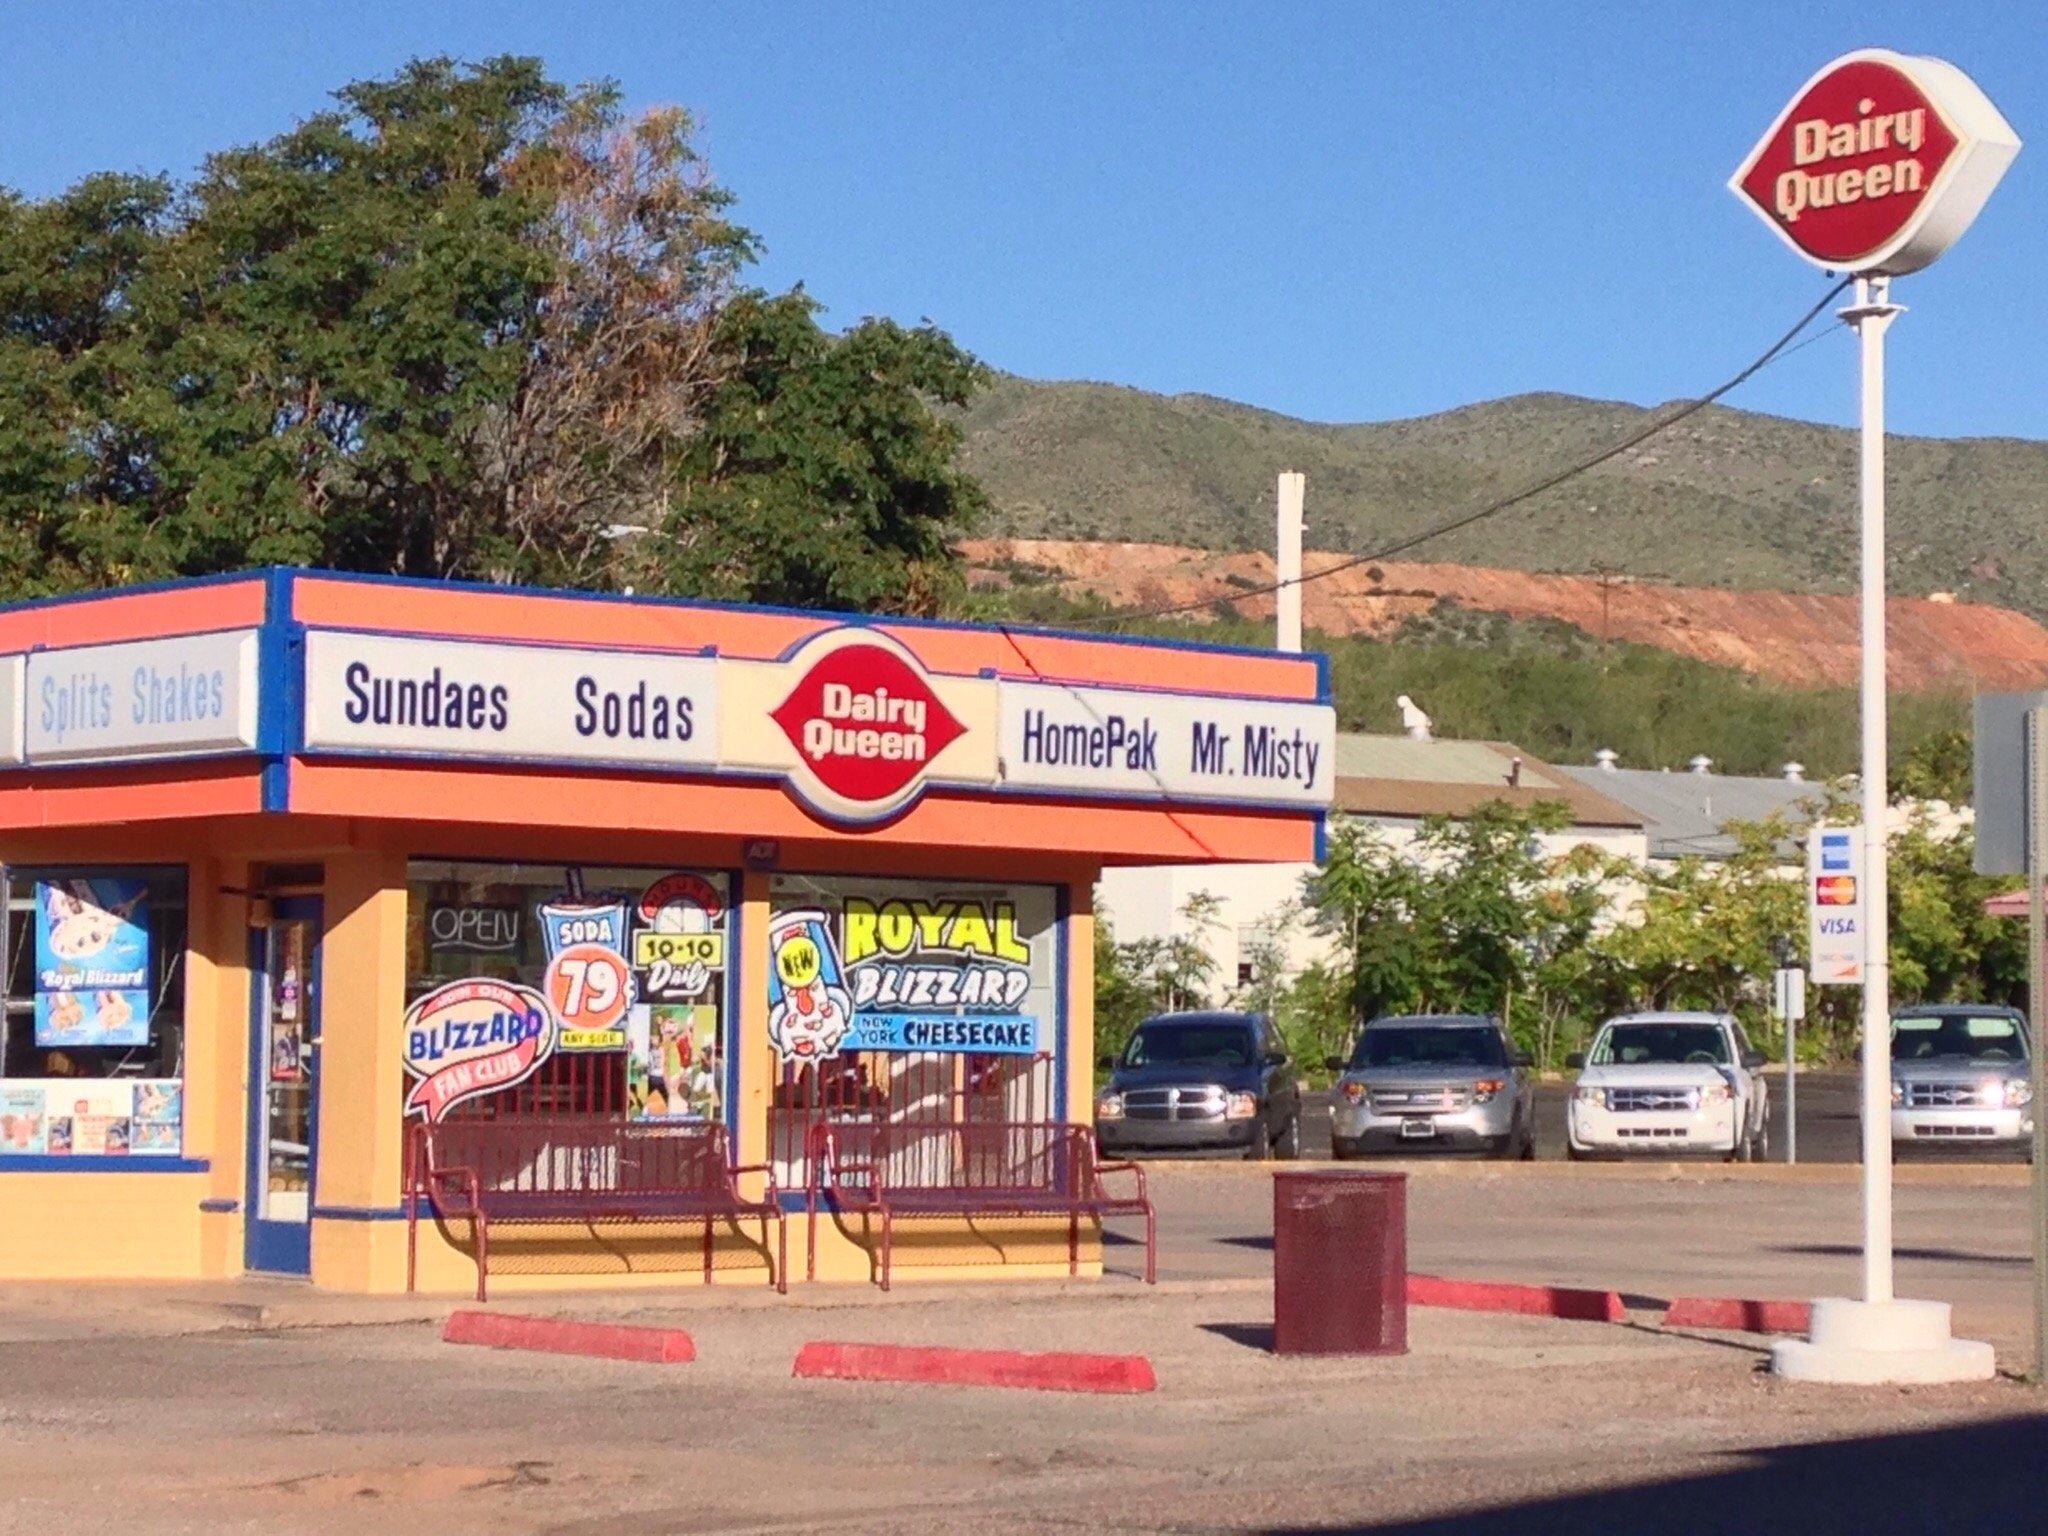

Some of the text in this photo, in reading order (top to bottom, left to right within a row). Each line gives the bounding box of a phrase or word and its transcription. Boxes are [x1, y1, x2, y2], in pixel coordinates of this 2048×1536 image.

[1794, 98, 1926, 166] Dairy
[1774, 158, 1926, 223] Queen
[41, 667, 224, 748] Splits Shakes
[345, 661, 694, 742] Sundaes Sodas
[822, 683, 927, 733] Dairy
[803, 722, 926, 762] Queen
[1022, 709, 1320, 788] HomePak Mr. Misty
[431, 908, 519, 943] OPEN
[559, 919, 614, 945] SODA
[845, 897, 1030, 967] ROYAL
[1819, 918, 1856, 934] VISA
[41, 969, 143, 990] Royal Blizzard
[648, 960, 710, 992] Daily
[782, 949, 813, 978] NEW
[855, 966, 1029, 1007] BLIZZARD
[409, 1007, 542, 1061] BLIZZARD
[860, 1028, 898, 1045] YORK
[862, 1016, 893, 1029] NEW
[902, 1020, 1032, 1048] CHEESECAKE
[432, 1051, 522, 1101] FAN CLUB
